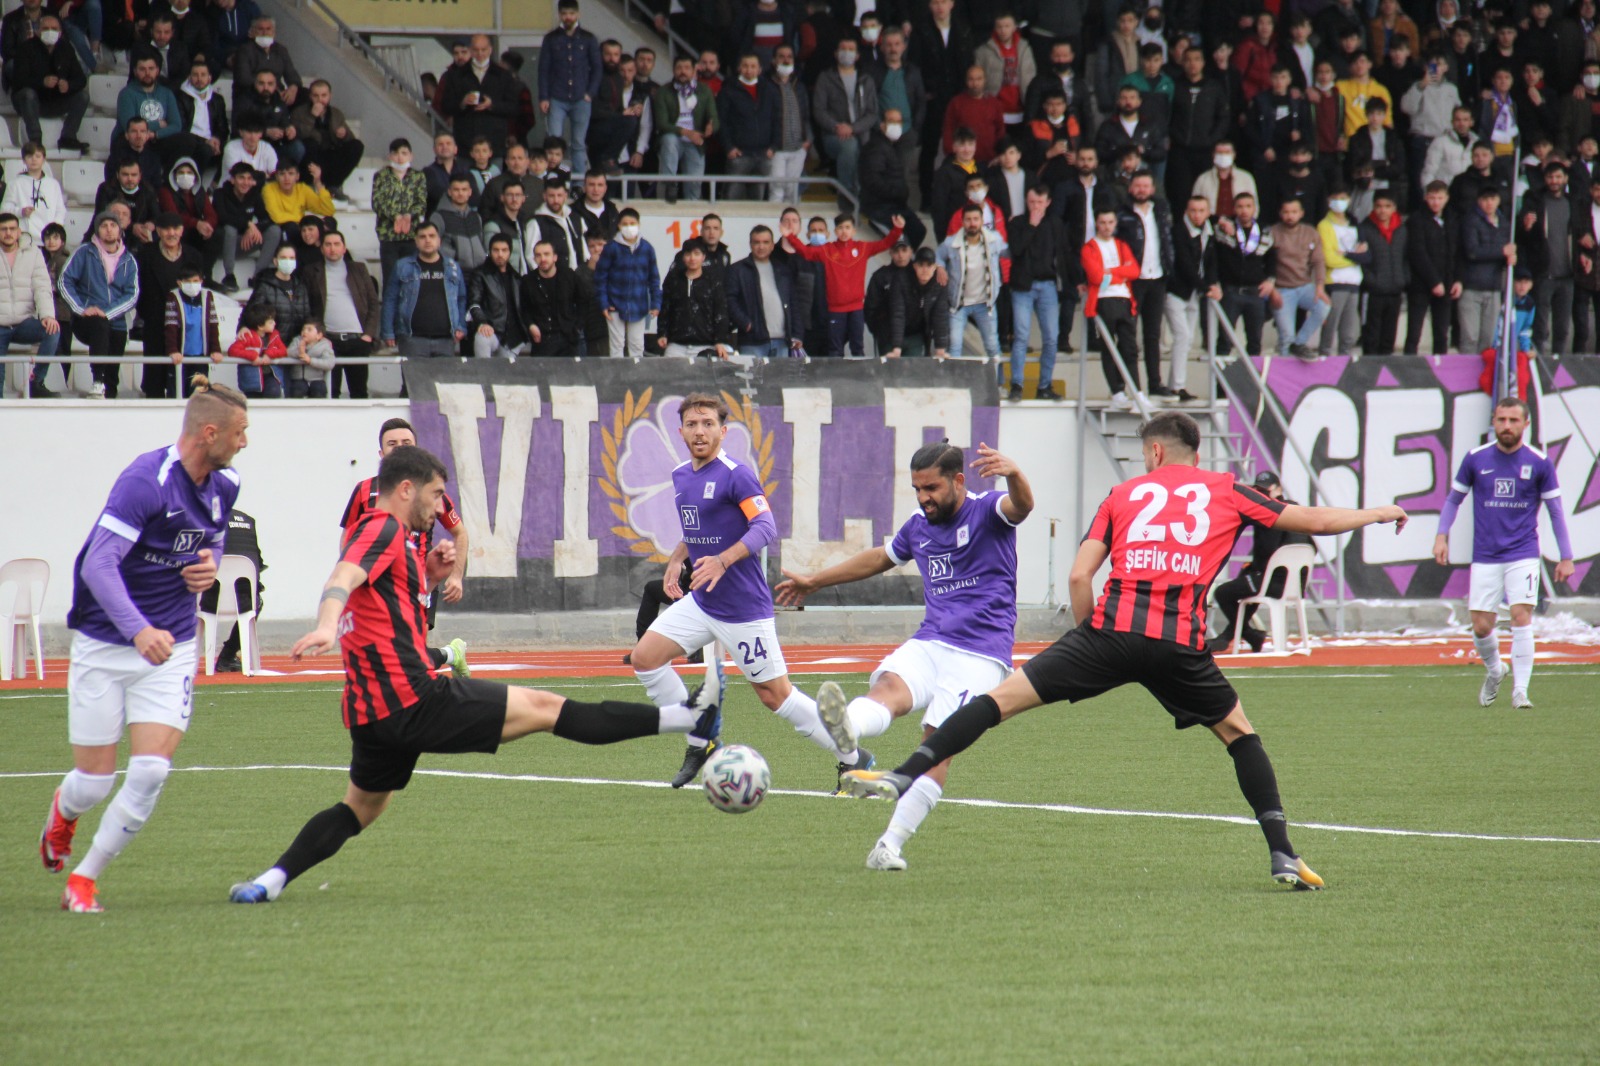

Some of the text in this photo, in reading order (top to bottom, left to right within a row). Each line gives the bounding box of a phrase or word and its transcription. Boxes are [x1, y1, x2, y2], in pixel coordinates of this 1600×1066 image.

[1126, 482, 1211, 546] 23
[1125, 545, 1201, 576] ŞEFİK CAN
[737, 636, 767, 665] 24
